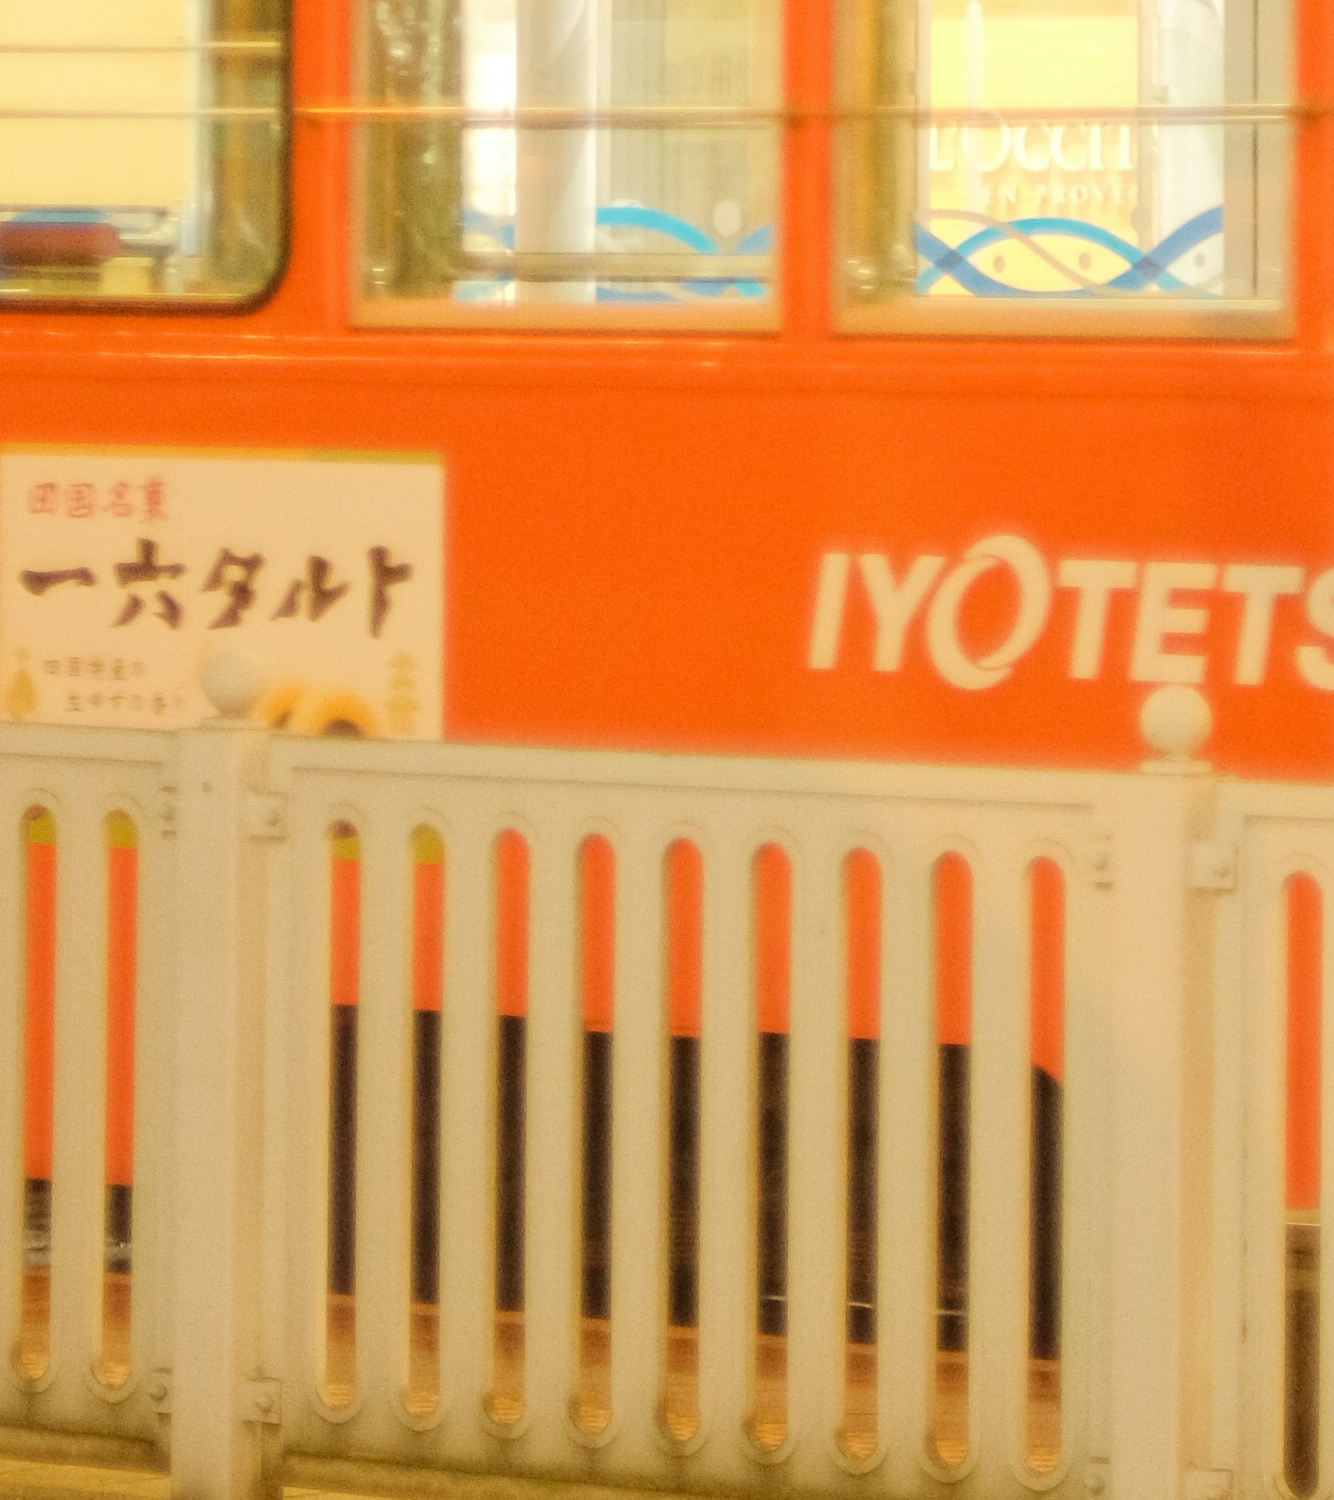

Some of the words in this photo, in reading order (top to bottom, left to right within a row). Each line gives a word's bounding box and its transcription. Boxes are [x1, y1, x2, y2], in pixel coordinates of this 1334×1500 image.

[19, 536, 414, 640] 一六タルト
